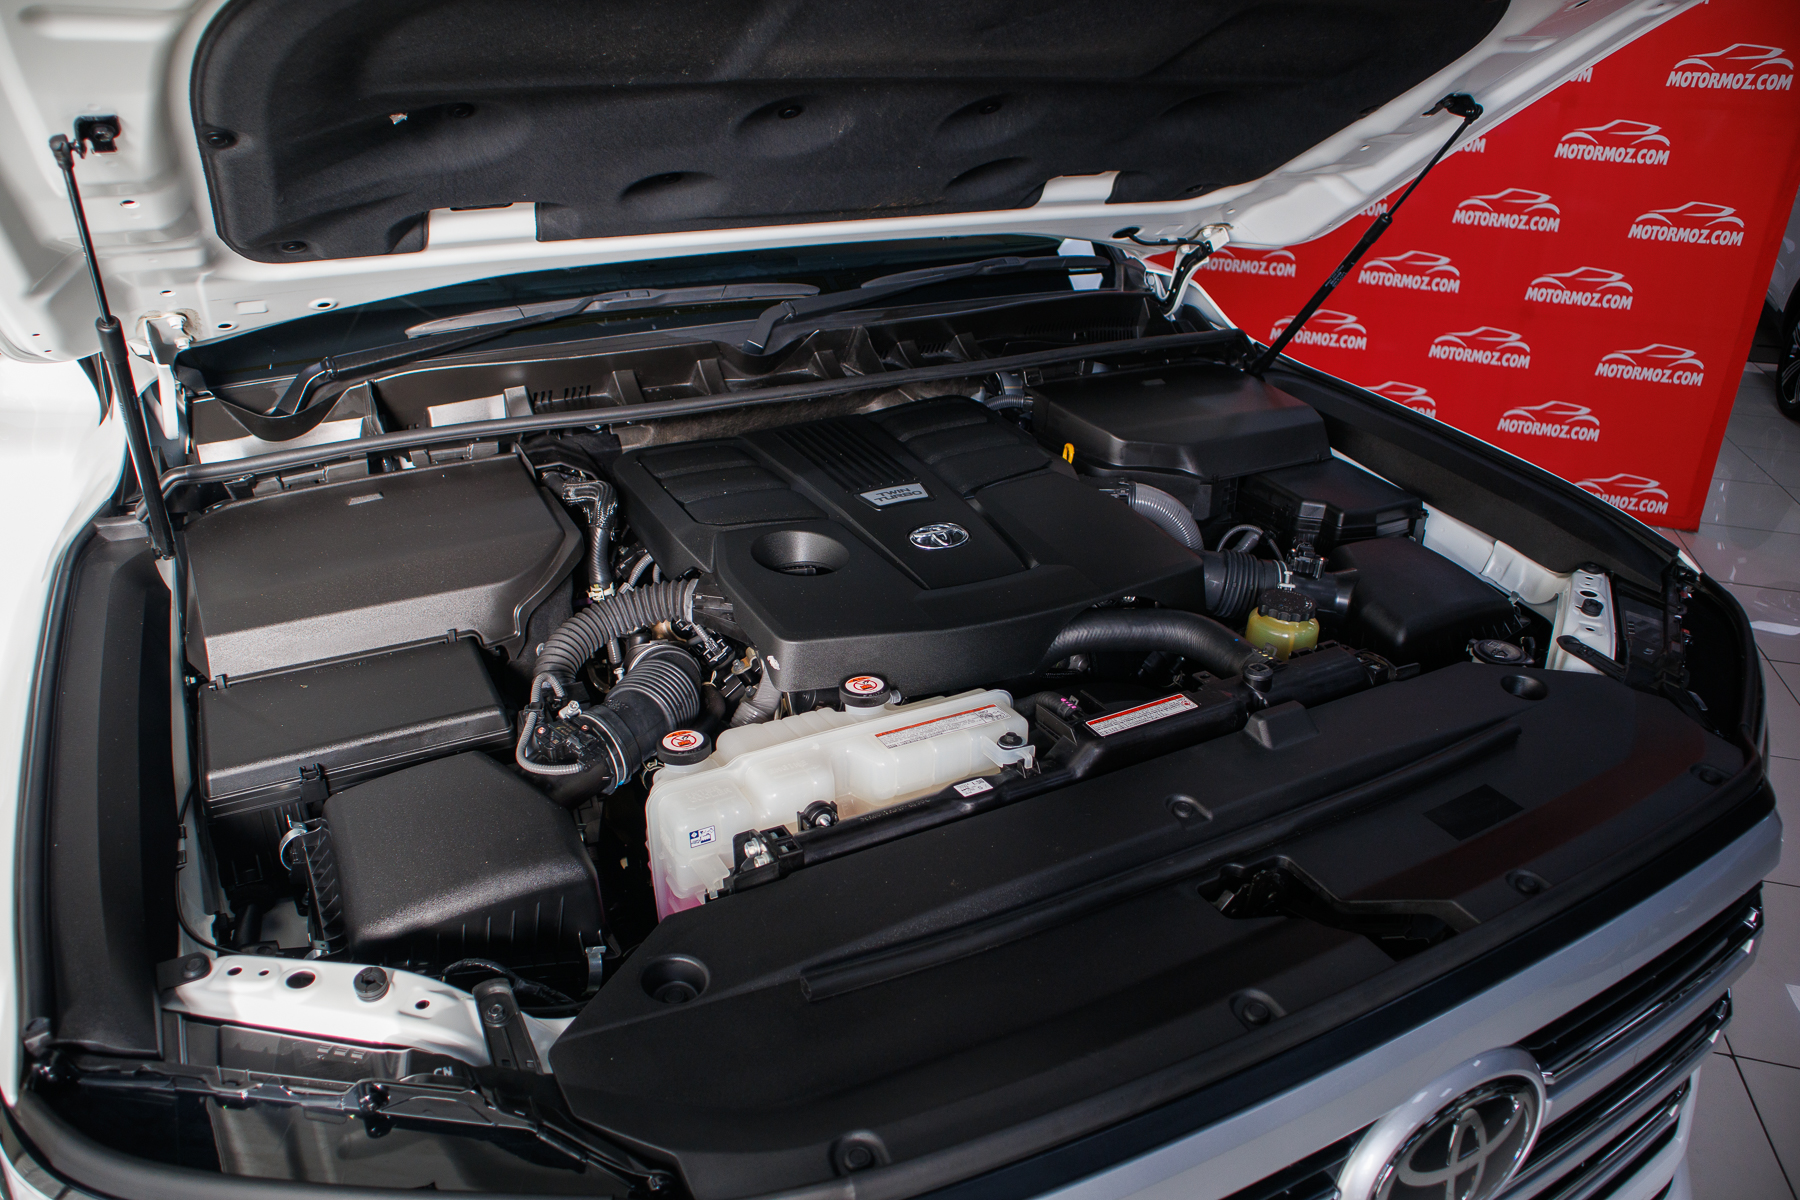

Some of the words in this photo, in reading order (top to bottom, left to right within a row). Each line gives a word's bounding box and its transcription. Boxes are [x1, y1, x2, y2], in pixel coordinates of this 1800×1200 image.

[1665, 71, 1794, 91] MOTORMOZ.COM
[1554, 142, 1670, 166] MOTORMOZ.COM
[1452, 209, 1560, 233] MOTORMOZ.COM
[1628, 223, 1744, 247] MOTORMOZ.COM
[1357, 269, 1460, 294] MOTORMOZ.COM
[1524, 287, 1633, 310] MOTORMOZ.COM
[1269, 327, 1367, 351] MORMOZ.COM
[1428, 344, 1530, 369] MOTORMOZ.COM
[1594, 362, 1704, 387] MOTORMOZ.COM
[1497, 417, 1600, 442] MOTORMOZ.COM
[873, 490, 923, 502] TURBO
[875, 487, 911, 497] TWIN
